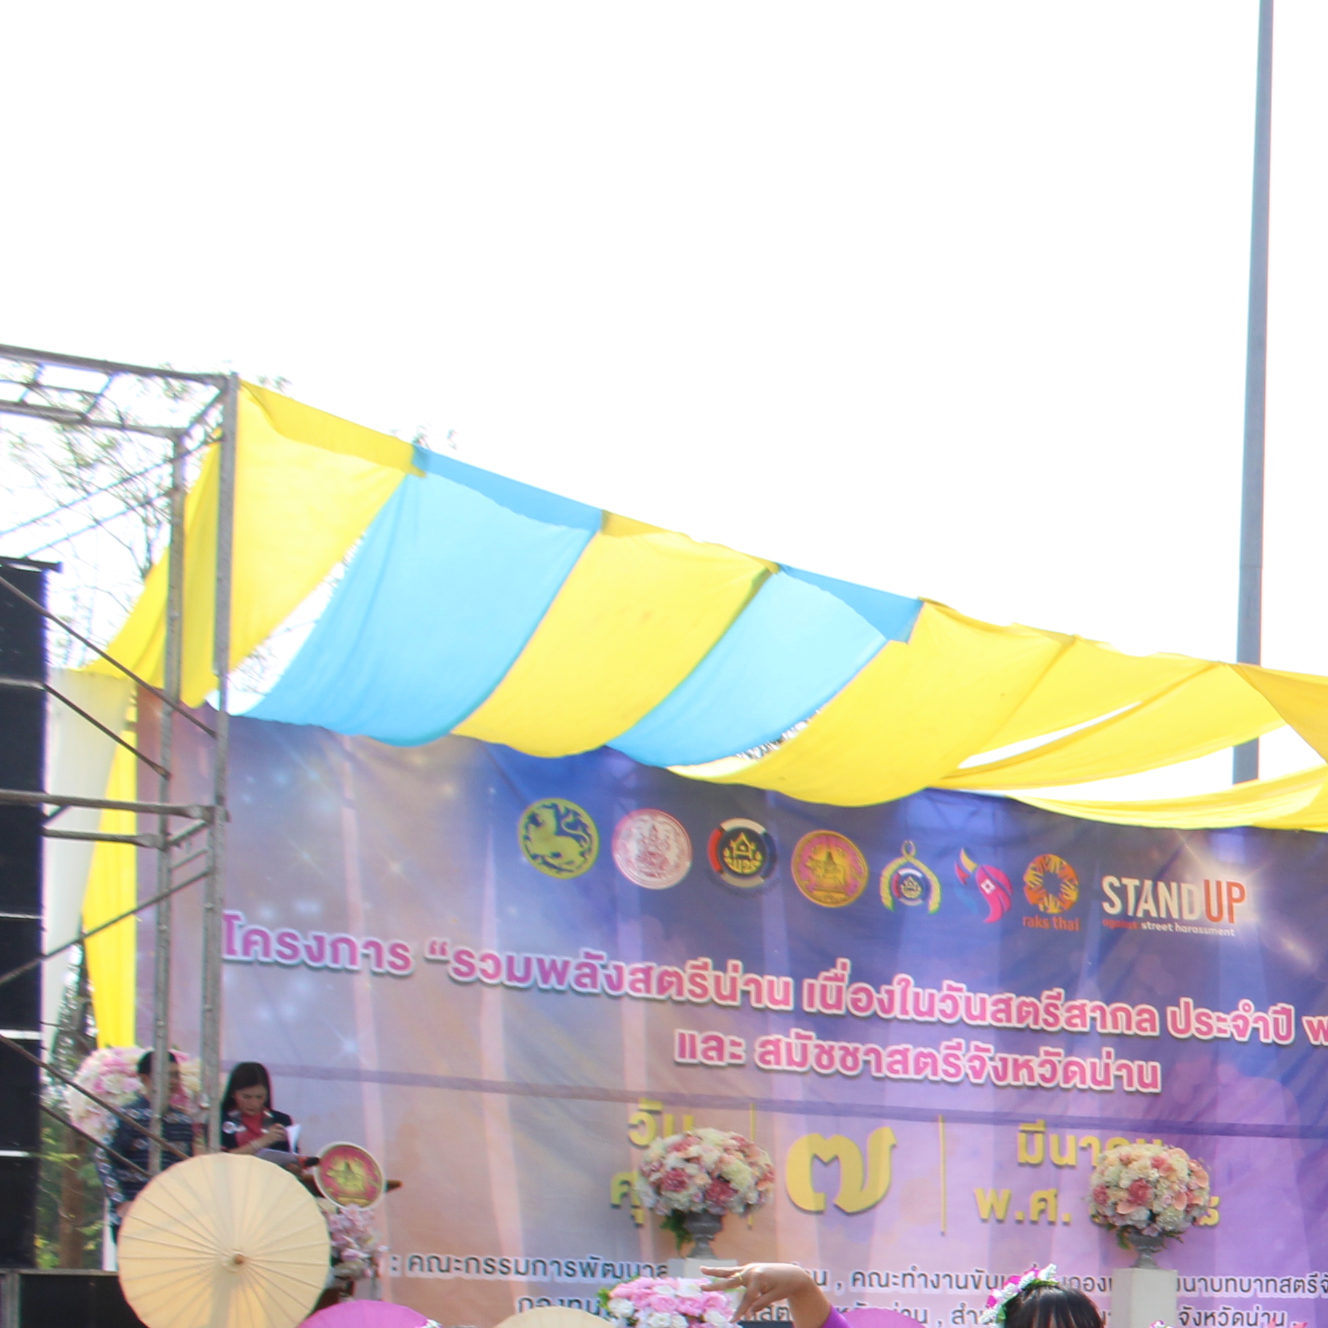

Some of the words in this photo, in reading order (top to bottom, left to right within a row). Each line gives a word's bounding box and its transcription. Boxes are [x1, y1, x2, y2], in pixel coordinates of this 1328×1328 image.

[1101, 875, 1200, 921] STAND
[1204, 879, 1247, 924] UP
[1023, 915, 1050, 929] raks
[1053, 917, 1080, 931] thai
[1141, 921, 1174, 932] street
[1175, 922, 1236, 937] harassment
[222, 912, 413, 975] โครงการ
[803, 958, 1159, 1036] เนื่องในวันสตรีสากล
[1167, 998, 1295, 1044] ประจำปี
[674, 1030, 746, 1065] และ
[754, 1028, 1161, 1093] สมัชชาสตรีจังหวัดน่าน
[974, 1187, 1072, 1224] พ.ศ.
